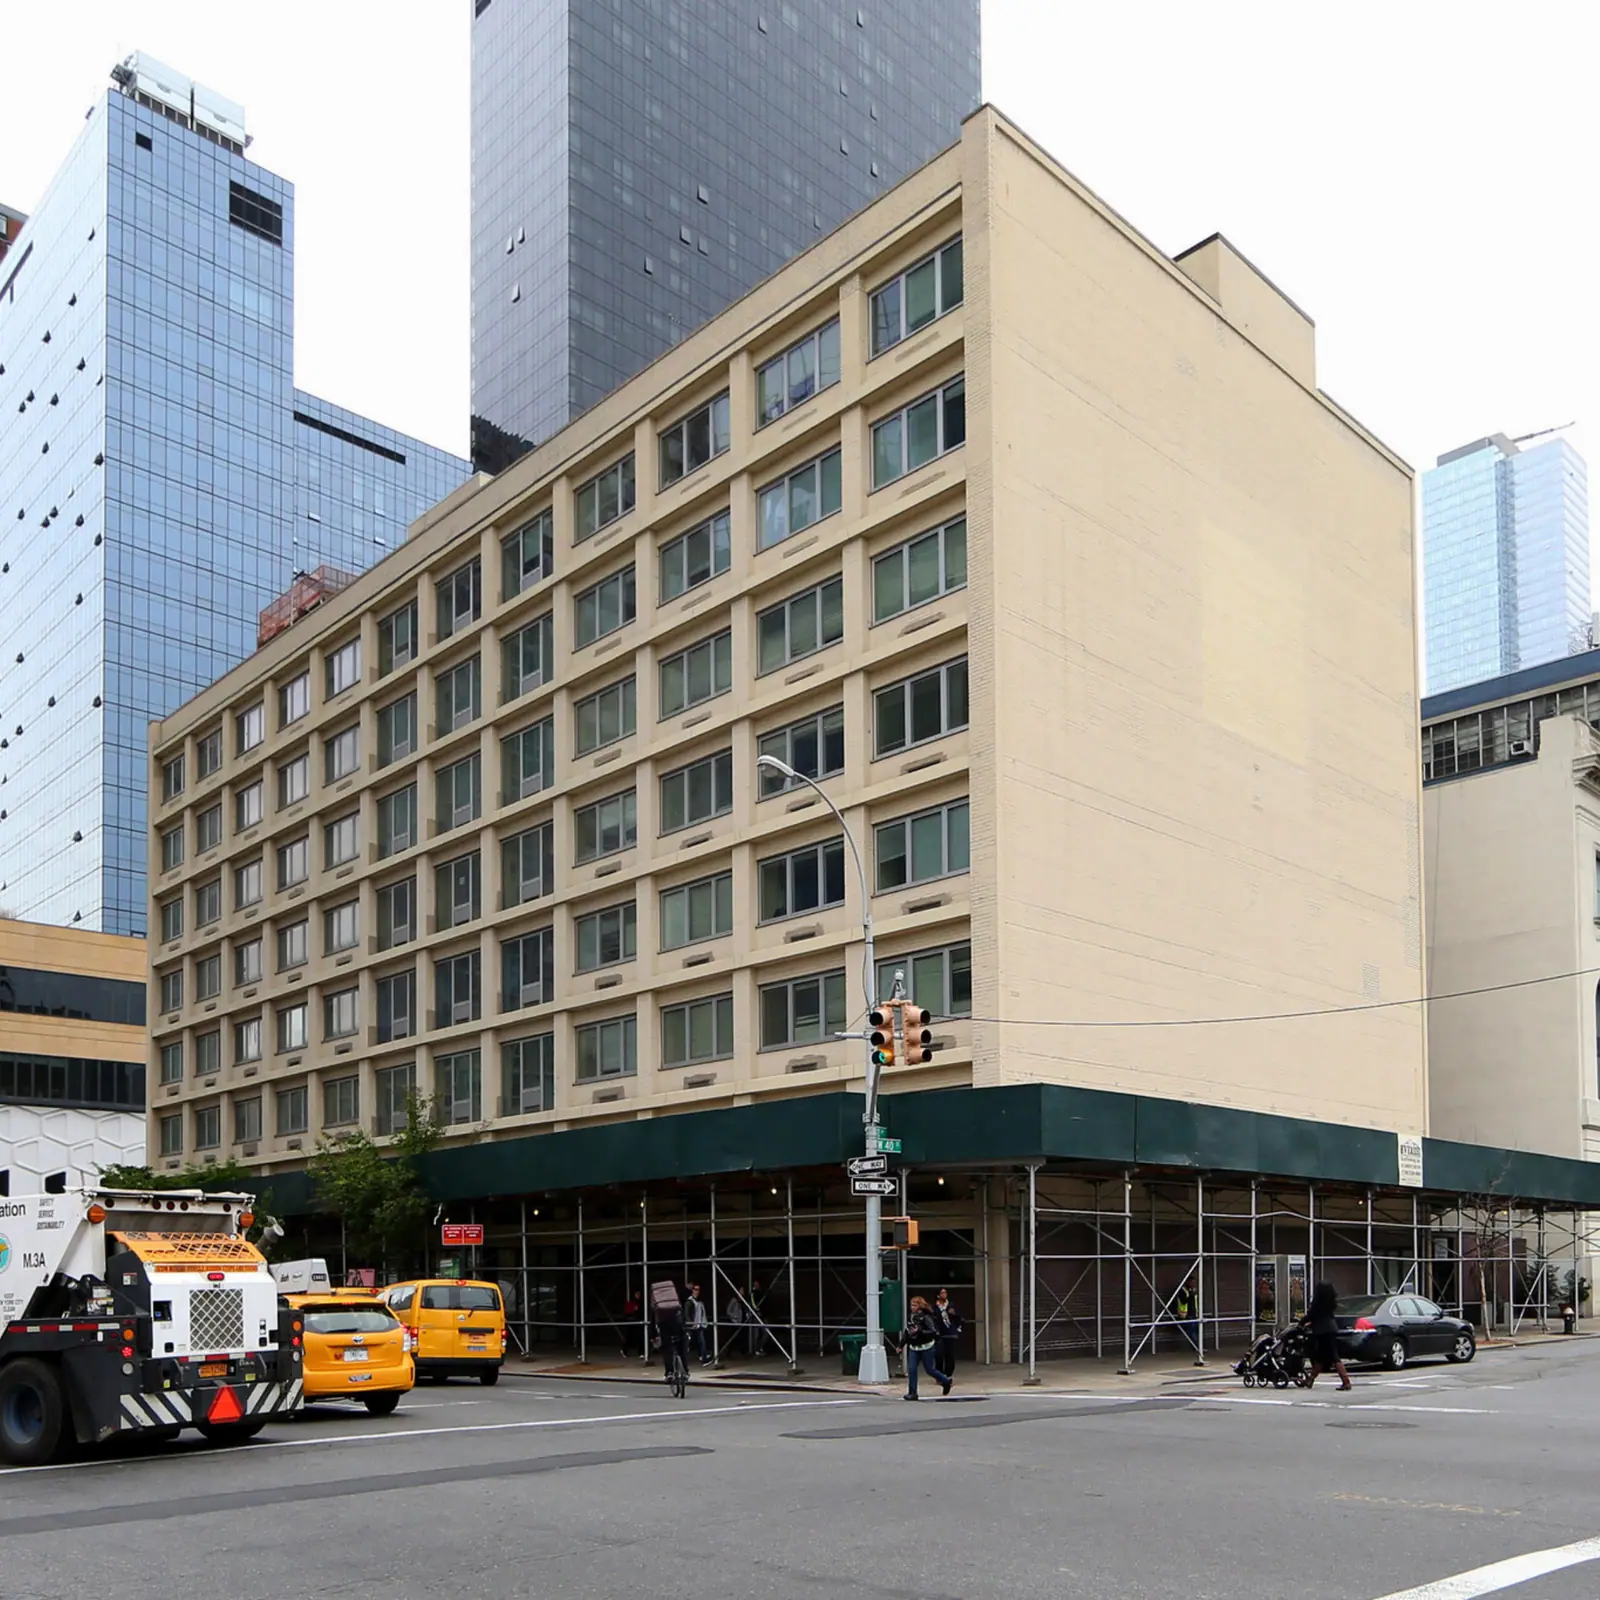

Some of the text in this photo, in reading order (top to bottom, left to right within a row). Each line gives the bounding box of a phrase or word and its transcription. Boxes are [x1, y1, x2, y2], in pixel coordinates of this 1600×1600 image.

[852, 1160, 882, 1171] ONE WAY
[23, 1252, 46, 1268] M.3A
